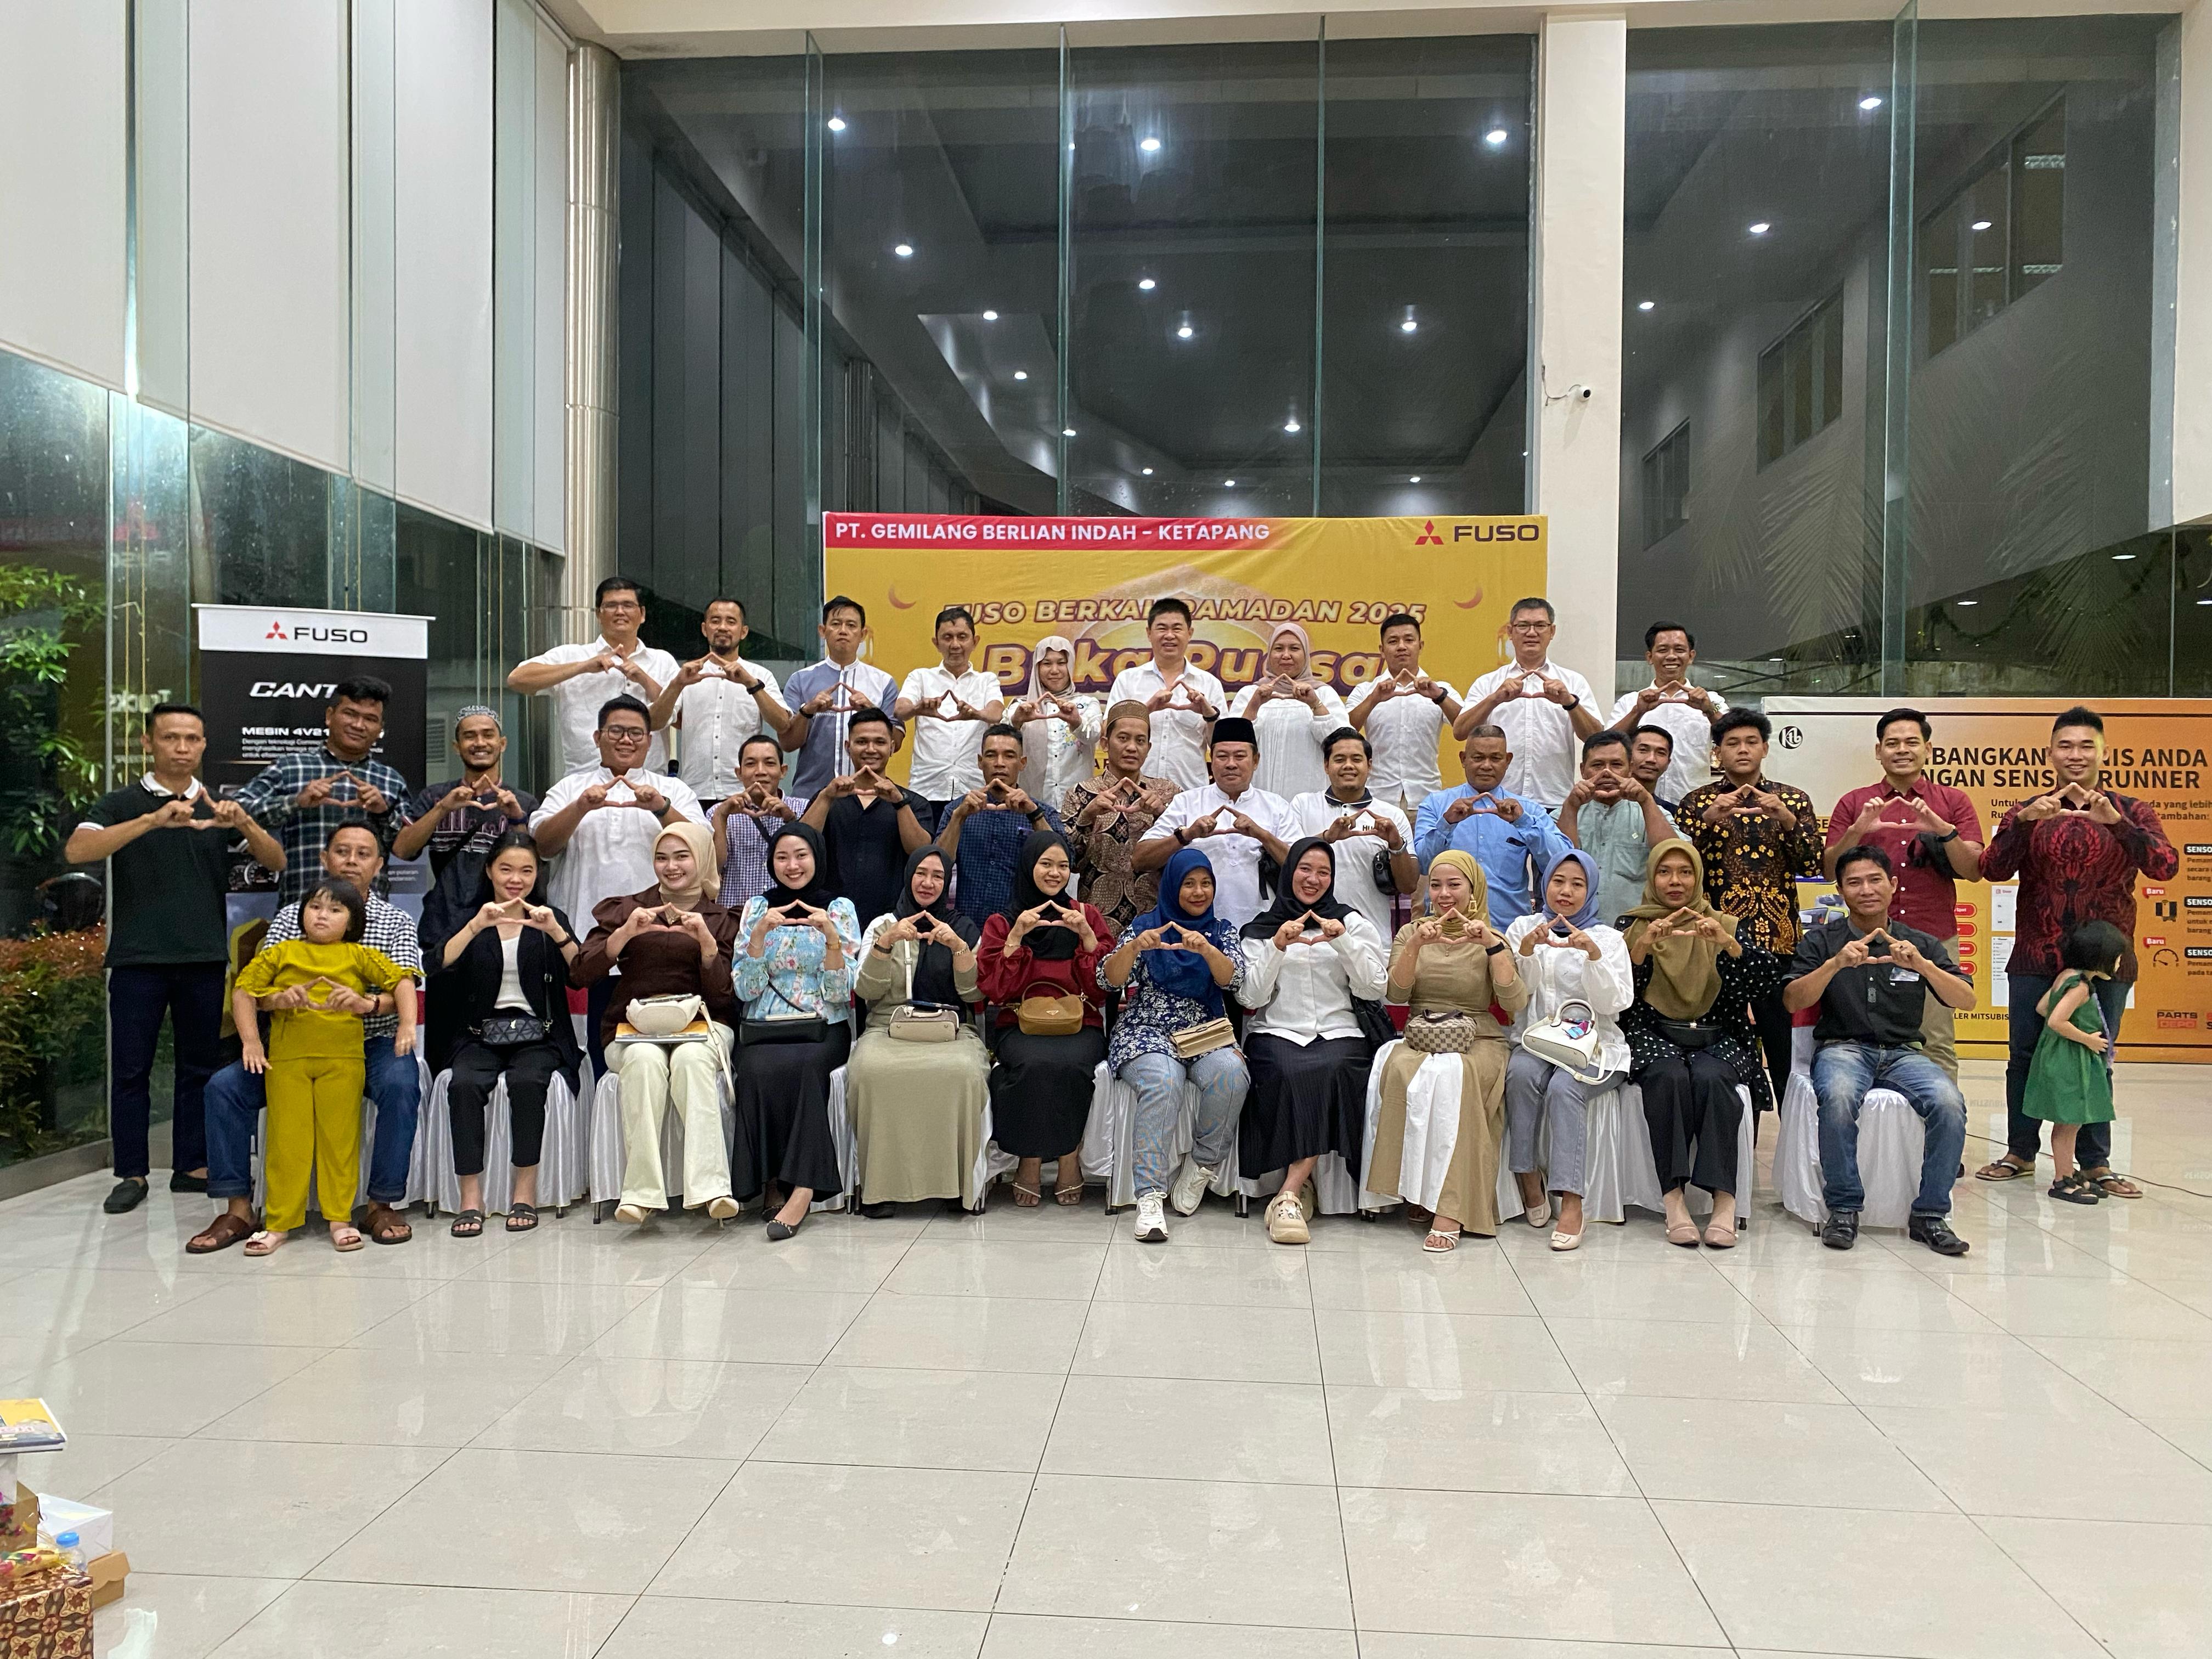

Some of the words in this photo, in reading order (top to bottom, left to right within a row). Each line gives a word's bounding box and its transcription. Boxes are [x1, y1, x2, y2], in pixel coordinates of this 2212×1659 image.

[836, 523, 865, 538] PT.
[871, 523, 977, 540] GEMILANG
[983, 524, 1066, 540] BERLIAN
[1071, 524, 1136, 540] INDAH
[1159, 524, 1269, 540] KETAPANG
[1454, 524, 1539, 542] FUSO
[294, 627, 368, 643] FUSO
[986, 640, 1154, 687] Bka
[1184, 642, 1381, 687] Pusa
[250, 682, 338, 698] CANT
[1925, 747, 2046, 766] BANGKAN
[2141, 748, 2208, 767] ANDA
[2098, 770, 2200, 788] RUNNER
[2146, 800, 2161, 808] da
[2163, 802, 2188, 810] yang
